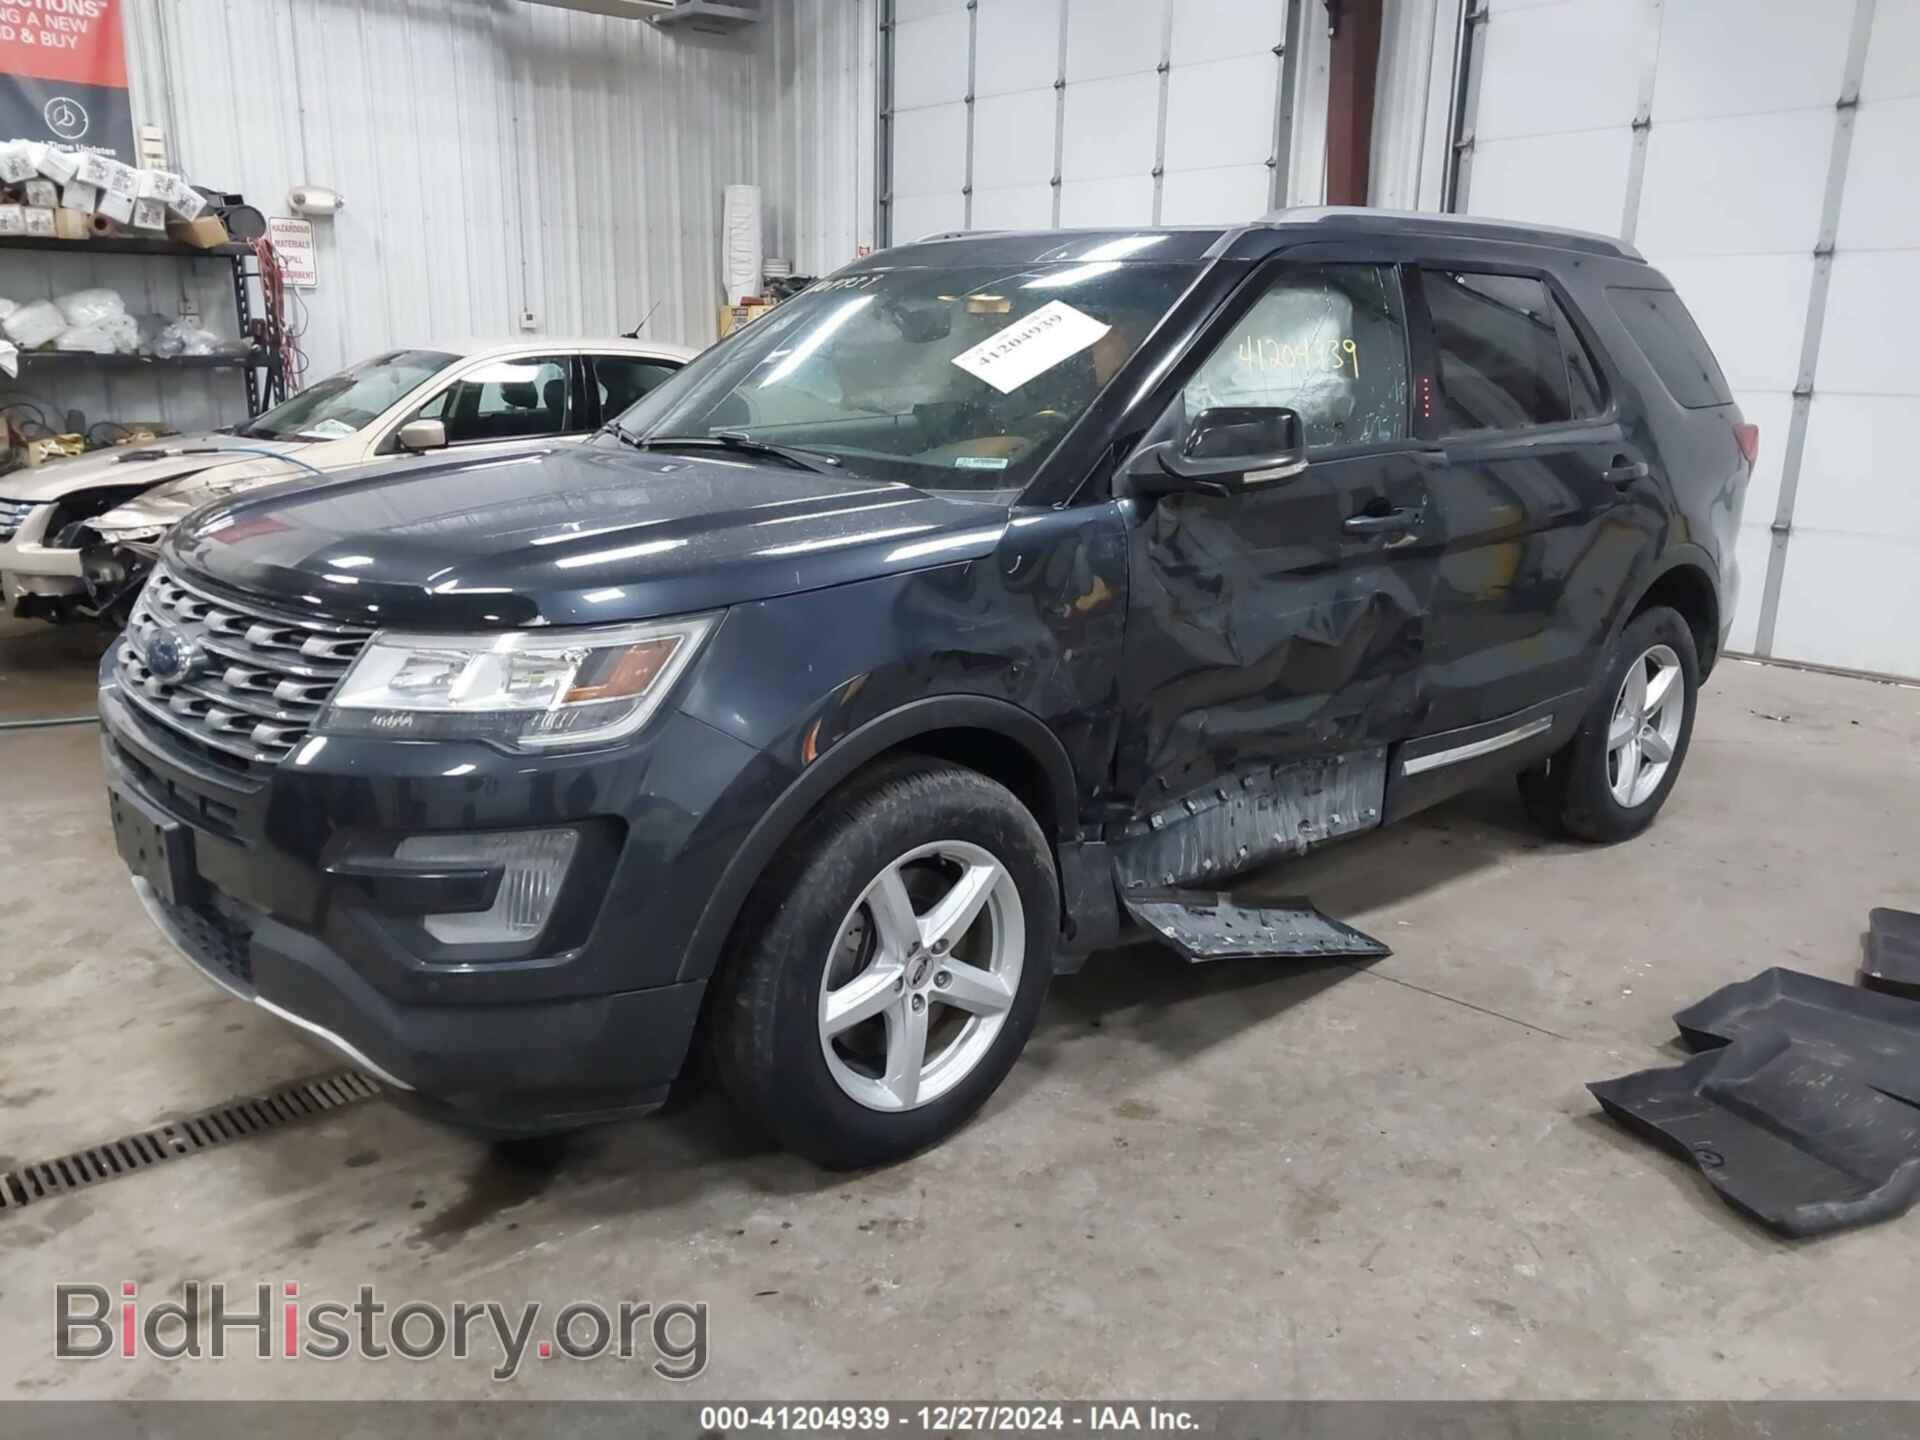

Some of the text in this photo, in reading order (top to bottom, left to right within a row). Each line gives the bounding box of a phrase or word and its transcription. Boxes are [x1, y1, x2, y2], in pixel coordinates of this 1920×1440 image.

[27, 11, 41, 27] A
[44, 14, 88, 33] NEW
[0, 25, 78, 49] D & BUY
[979, 304, 1063, 366] 41204939
